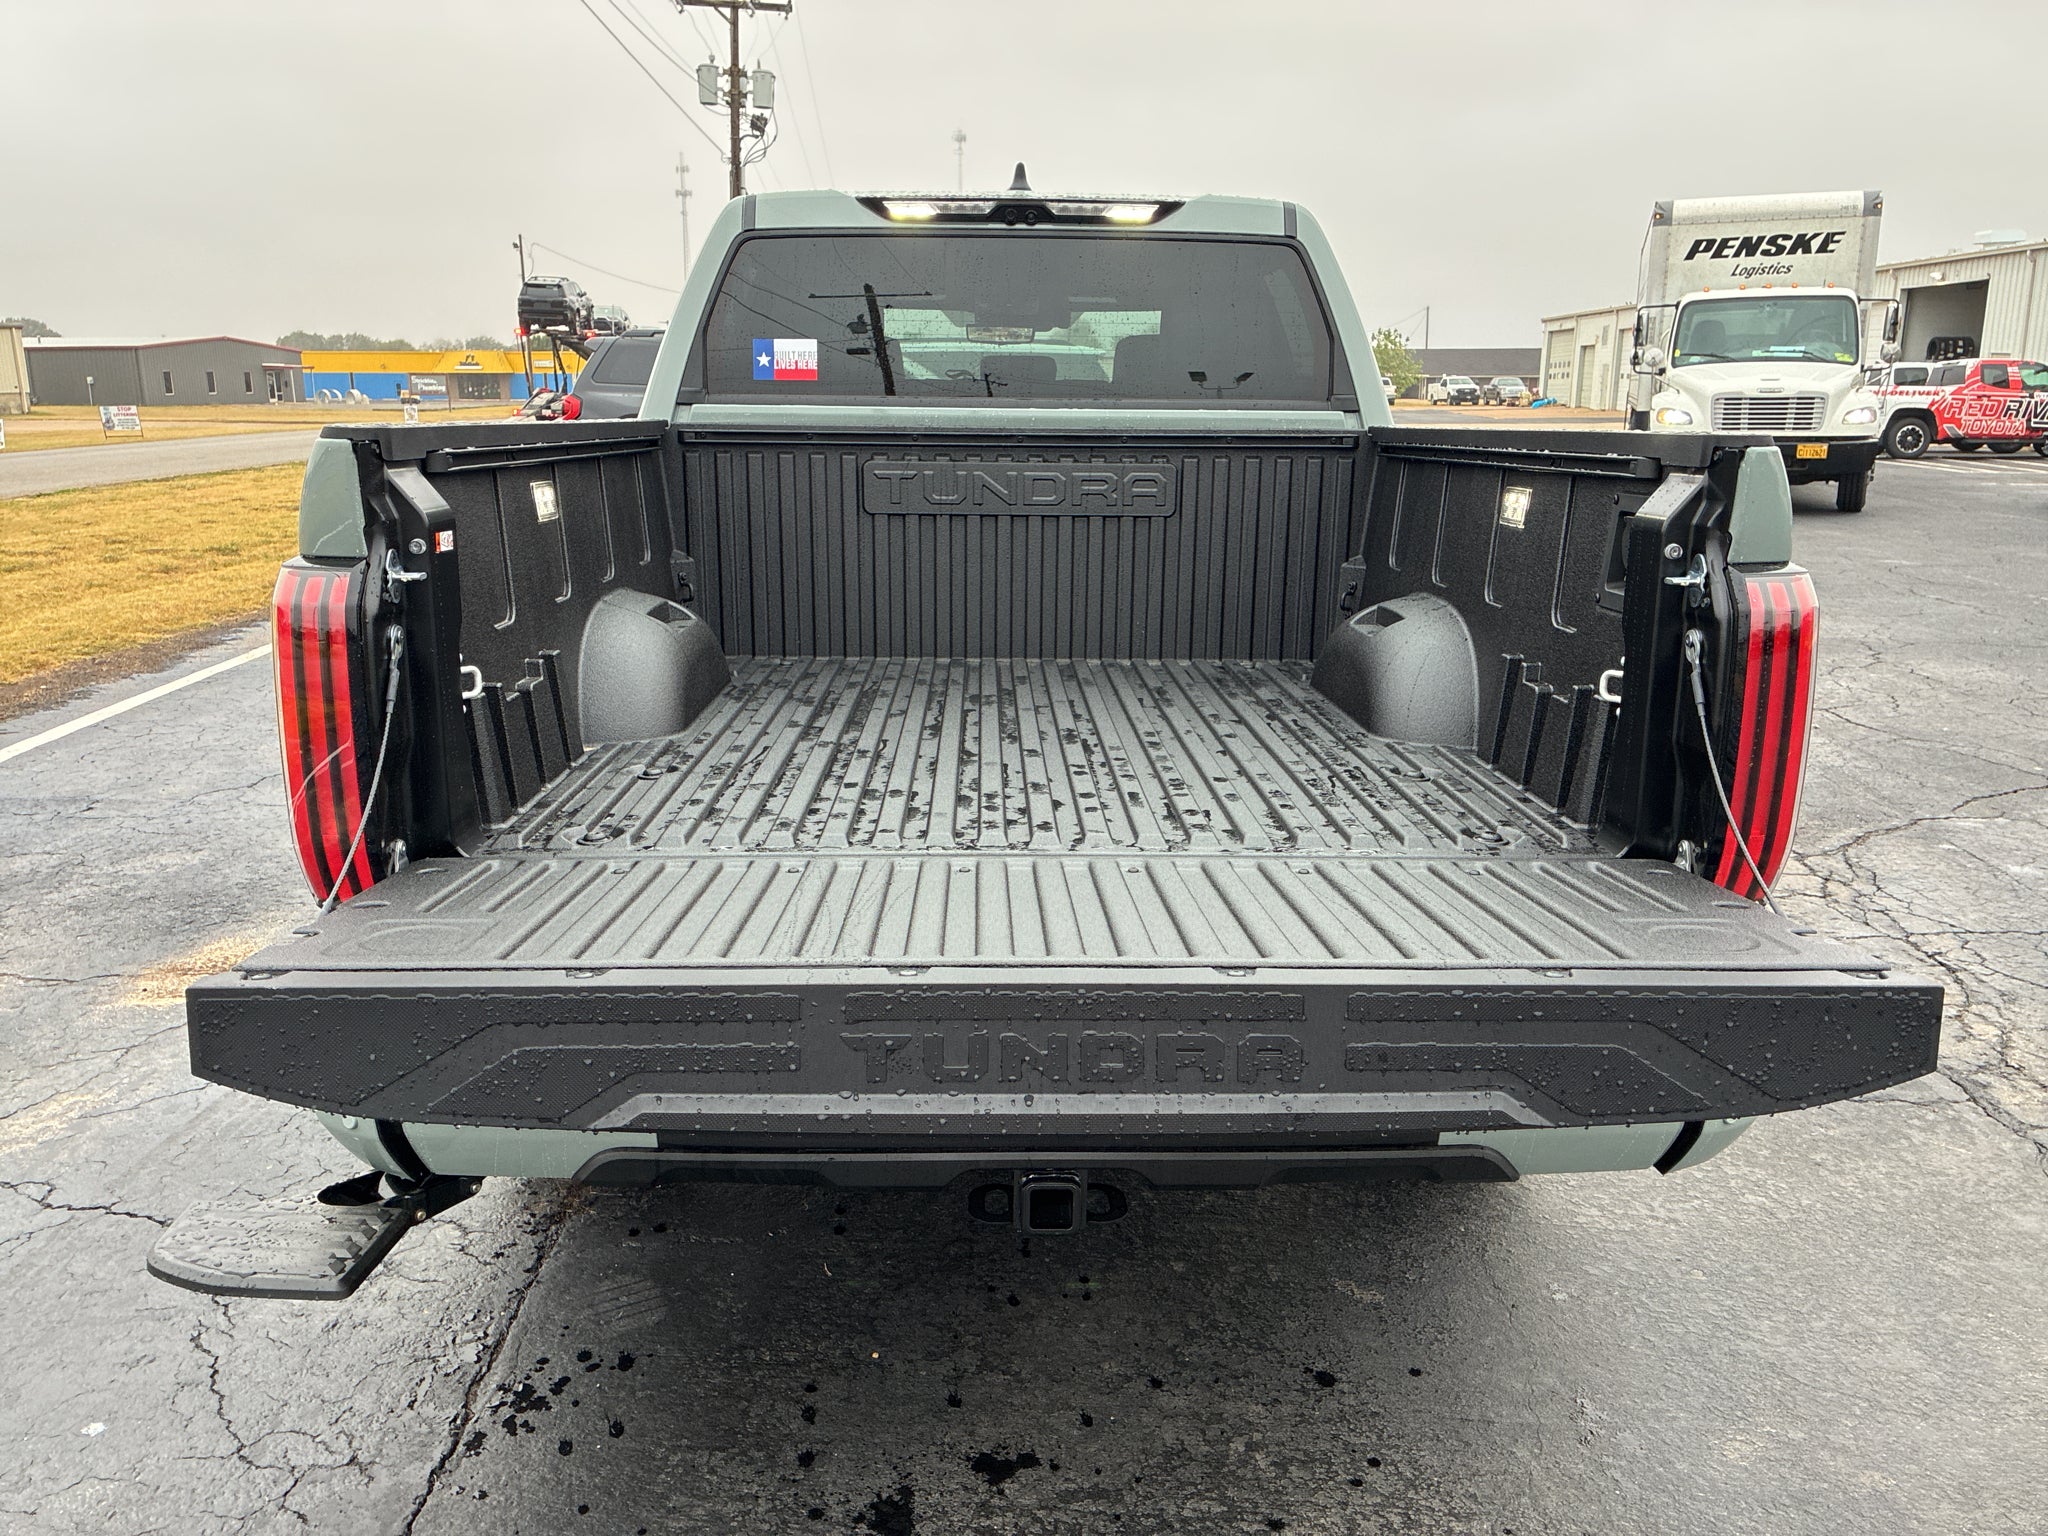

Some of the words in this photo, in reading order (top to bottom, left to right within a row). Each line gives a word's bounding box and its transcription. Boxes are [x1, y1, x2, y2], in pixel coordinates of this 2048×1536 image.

[1684, 231, 1847, 261] PENSKE
[1731, 262, 1794, 279] Logistics
[798, 350, 817, 360] HERE
[775, 359, 795, 369] LIVES
[798, 359, 818, 369] HERE
[1961, 419, 2027, 435] TOYOTA
[873, 470, 1168, 507] TUNDRA
[839, 1031, 1303, 1084] TUNDRA
